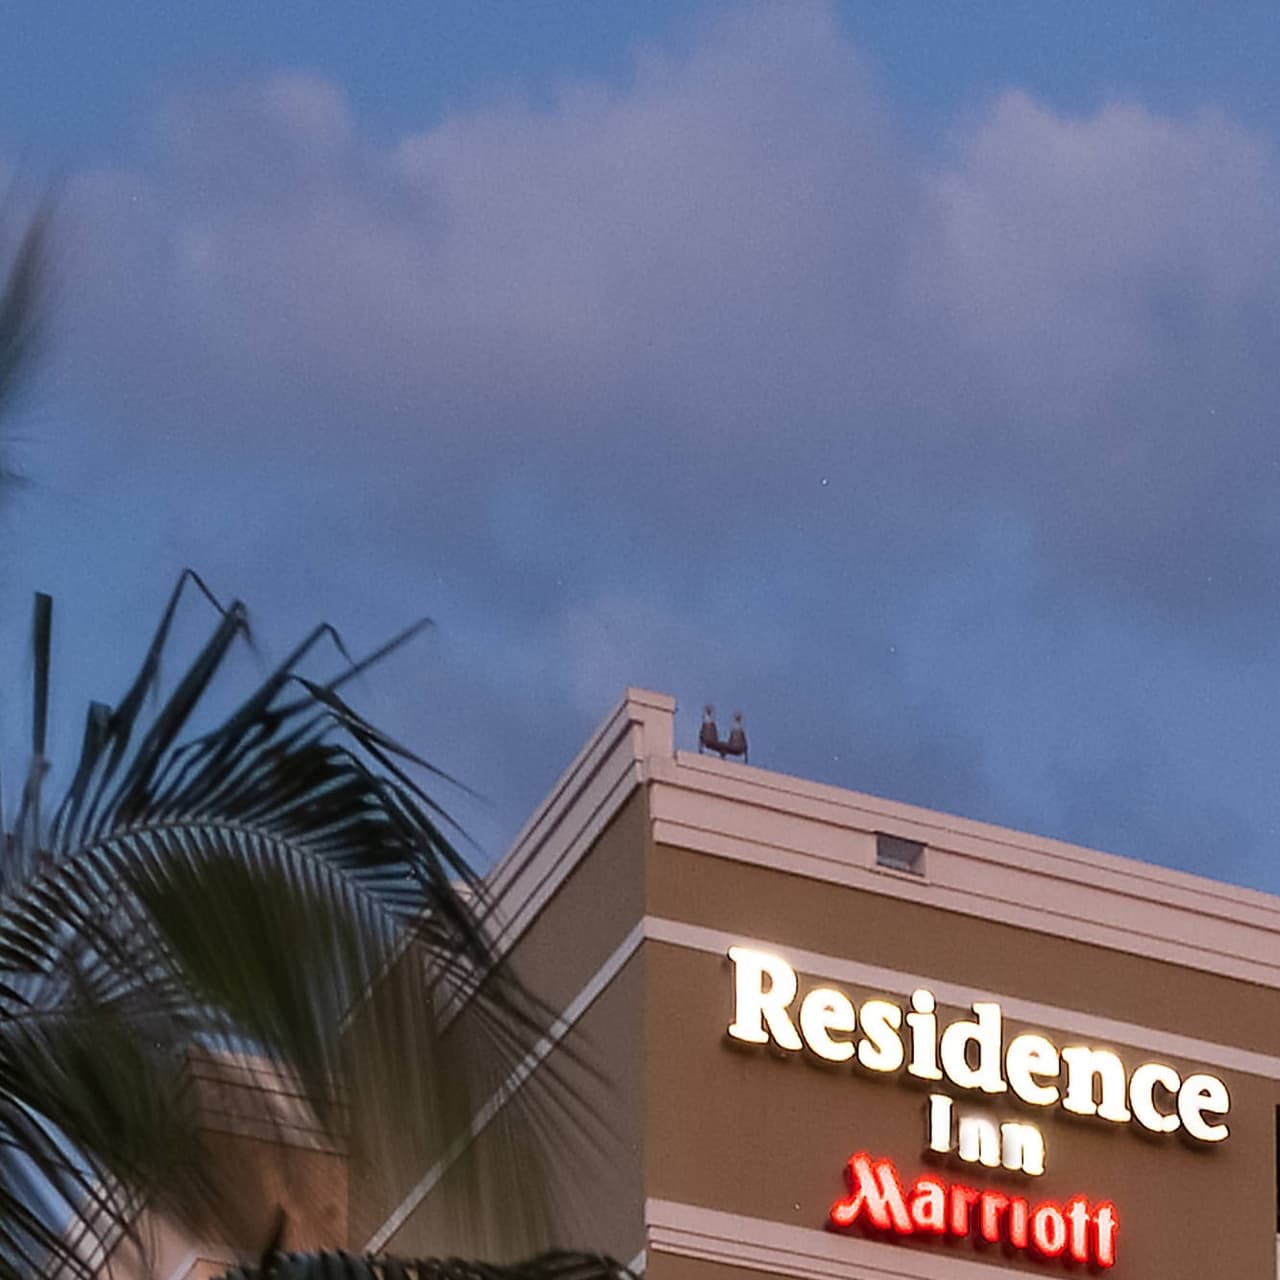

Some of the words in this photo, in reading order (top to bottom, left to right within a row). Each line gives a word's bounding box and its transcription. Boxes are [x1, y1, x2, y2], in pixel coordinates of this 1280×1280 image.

[728, 945, 1229, 1141] Residence
[929, 1094, 1045, 1176] Inn
[830, 1152, 1119, 1268] Marriott
